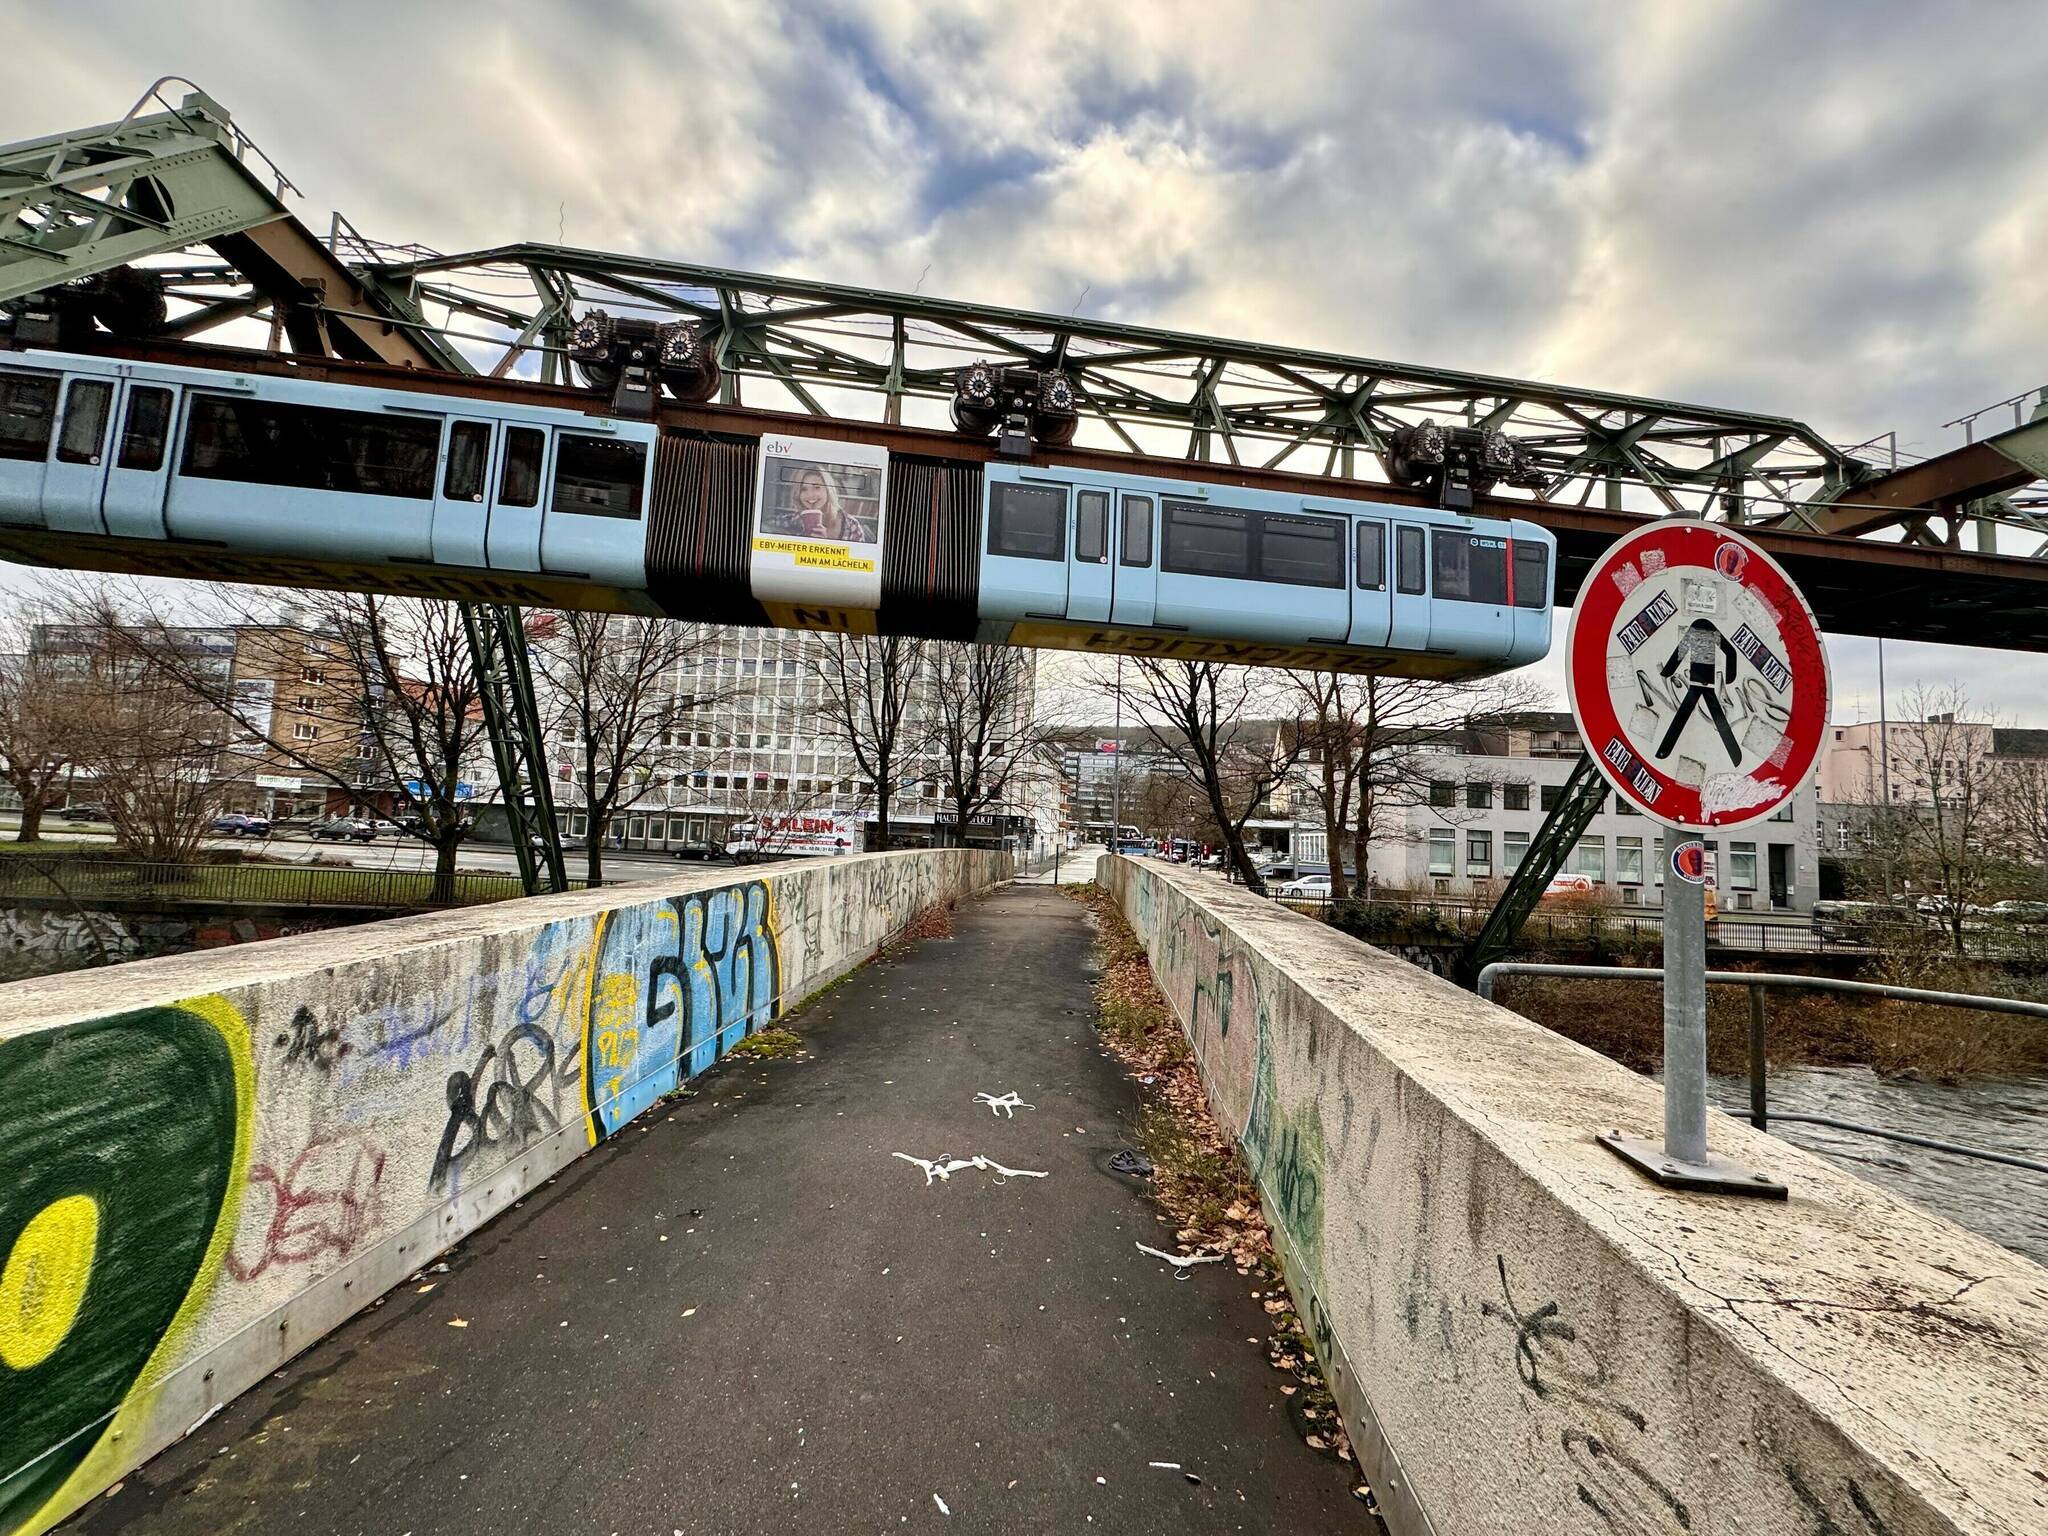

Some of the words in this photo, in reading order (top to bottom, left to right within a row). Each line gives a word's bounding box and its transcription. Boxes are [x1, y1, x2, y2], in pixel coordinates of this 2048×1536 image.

[759, 541, 807, 553] EBV-MIETER
[809, 545, 846, 556] ERKENNT
[799, 556, 818, 565] MAN
[819, 558, 831, 566] AM
[1620, 619, 1647, 652] BAR
[1647, 591, 1676, 624] MEN
[1733, 627, 1759, 661] BAR
[1762, 657, 1792, 692] MEN
[1604, 738, 1632, 773] BAR
[1632, 767, 1663, 804] MEN
[780, 817, 834, 833] KLEIN
